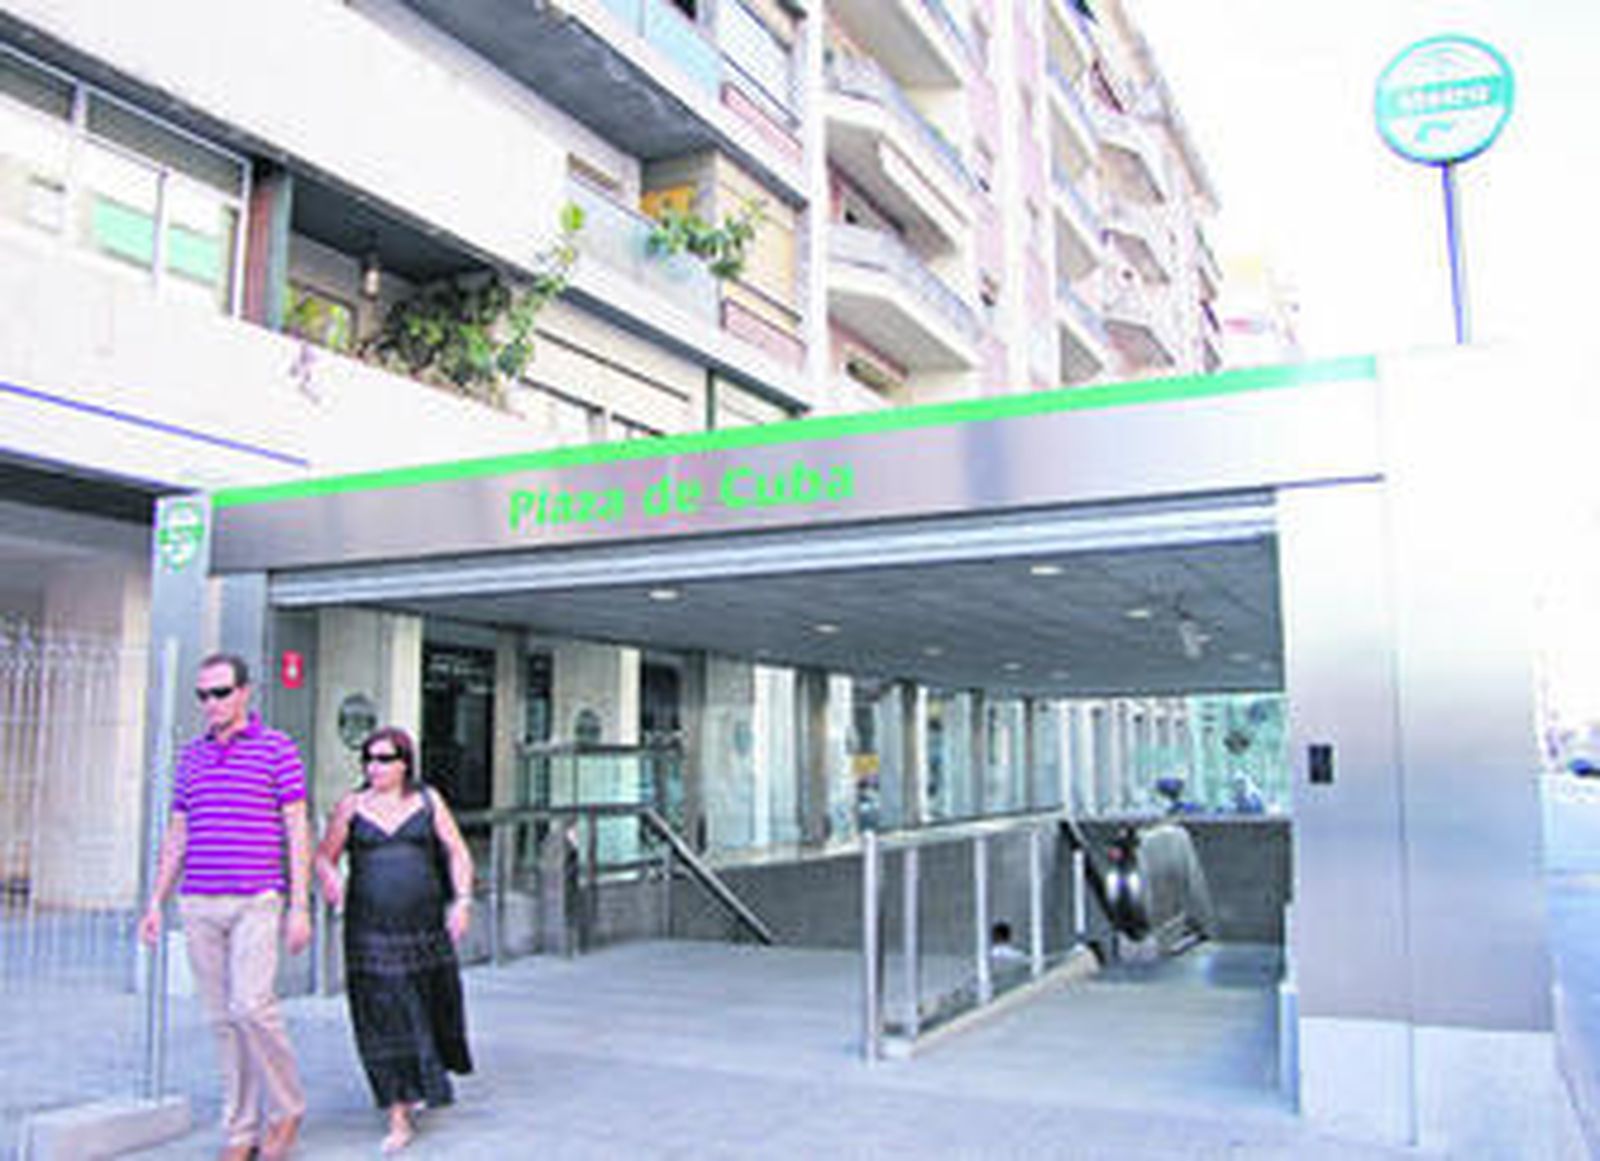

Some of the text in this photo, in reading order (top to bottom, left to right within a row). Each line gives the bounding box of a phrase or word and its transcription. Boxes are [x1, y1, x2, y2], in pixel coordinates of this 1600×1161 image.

[508, 461, 854, 530] Plaza de Cuba
